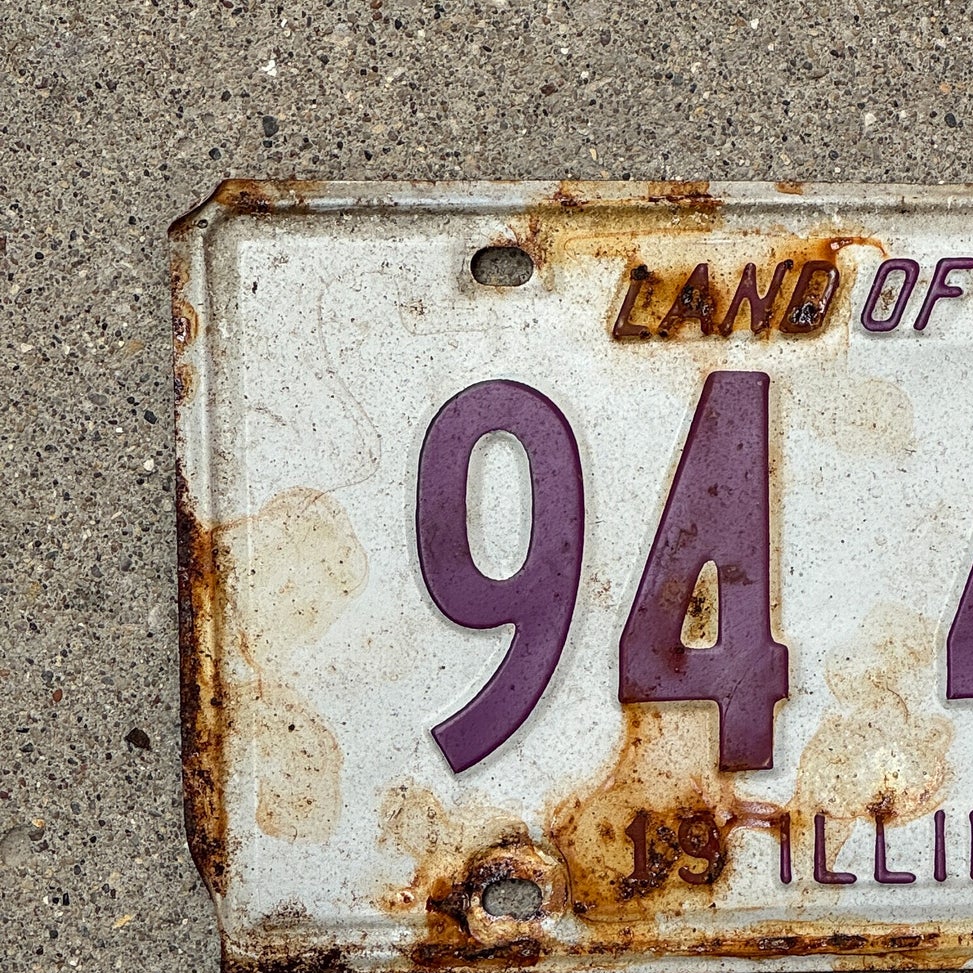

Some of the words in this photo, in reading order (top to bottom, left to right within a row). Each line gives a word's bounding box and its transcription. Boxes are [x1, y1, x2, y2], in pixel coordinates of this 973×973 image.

[611, 259, 842, 339] LAND
[417, 370, 788, 773] 94
[624, 810, 725, 885] 19
